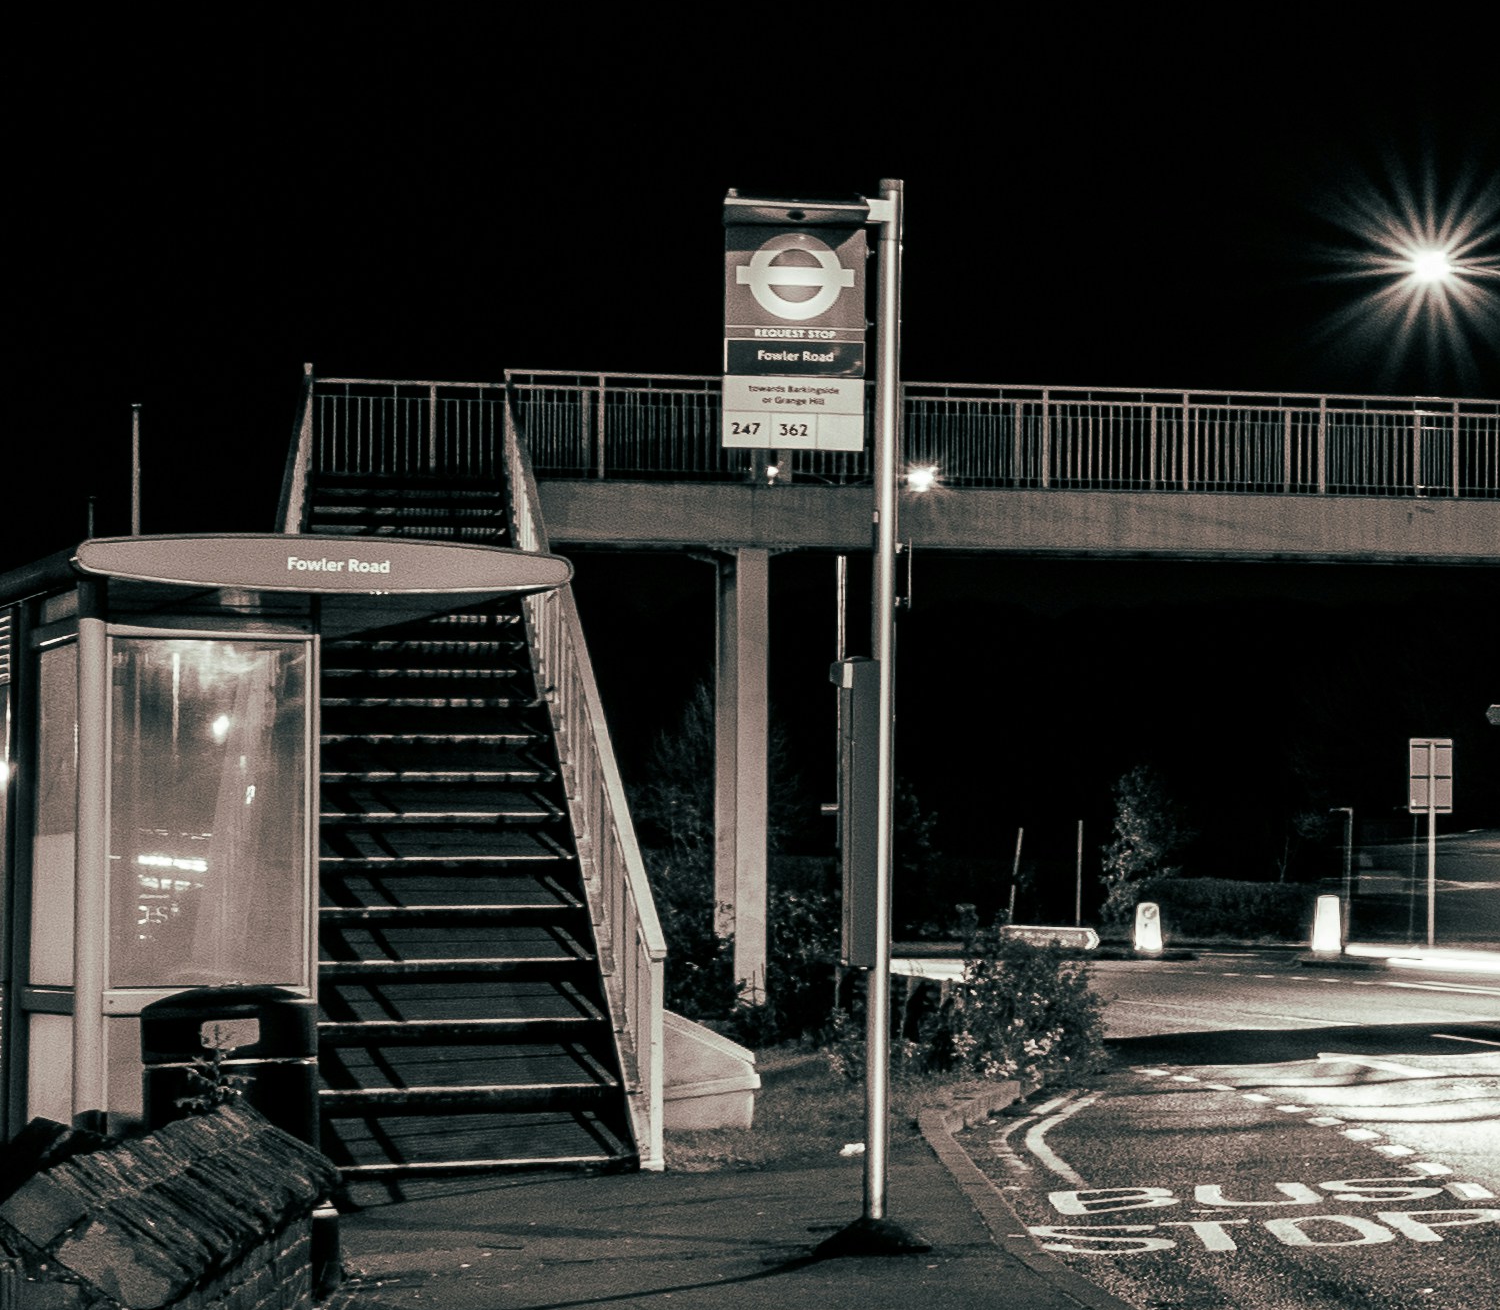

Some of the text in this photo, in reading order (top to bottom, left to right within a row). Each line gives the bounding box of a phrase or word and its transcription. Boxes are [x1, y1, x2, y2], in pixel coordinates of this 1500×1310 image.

[754, 328, 837, 339] REQUEST STOP
[757, 350, 834, 362] Fowler Road
[731, 421, 761, 435] 247
[779, 423, 808, 437] 362
[287, 556, 391, 574] Fowler Road
[1048, 1175, 1444, 1216] BUS
